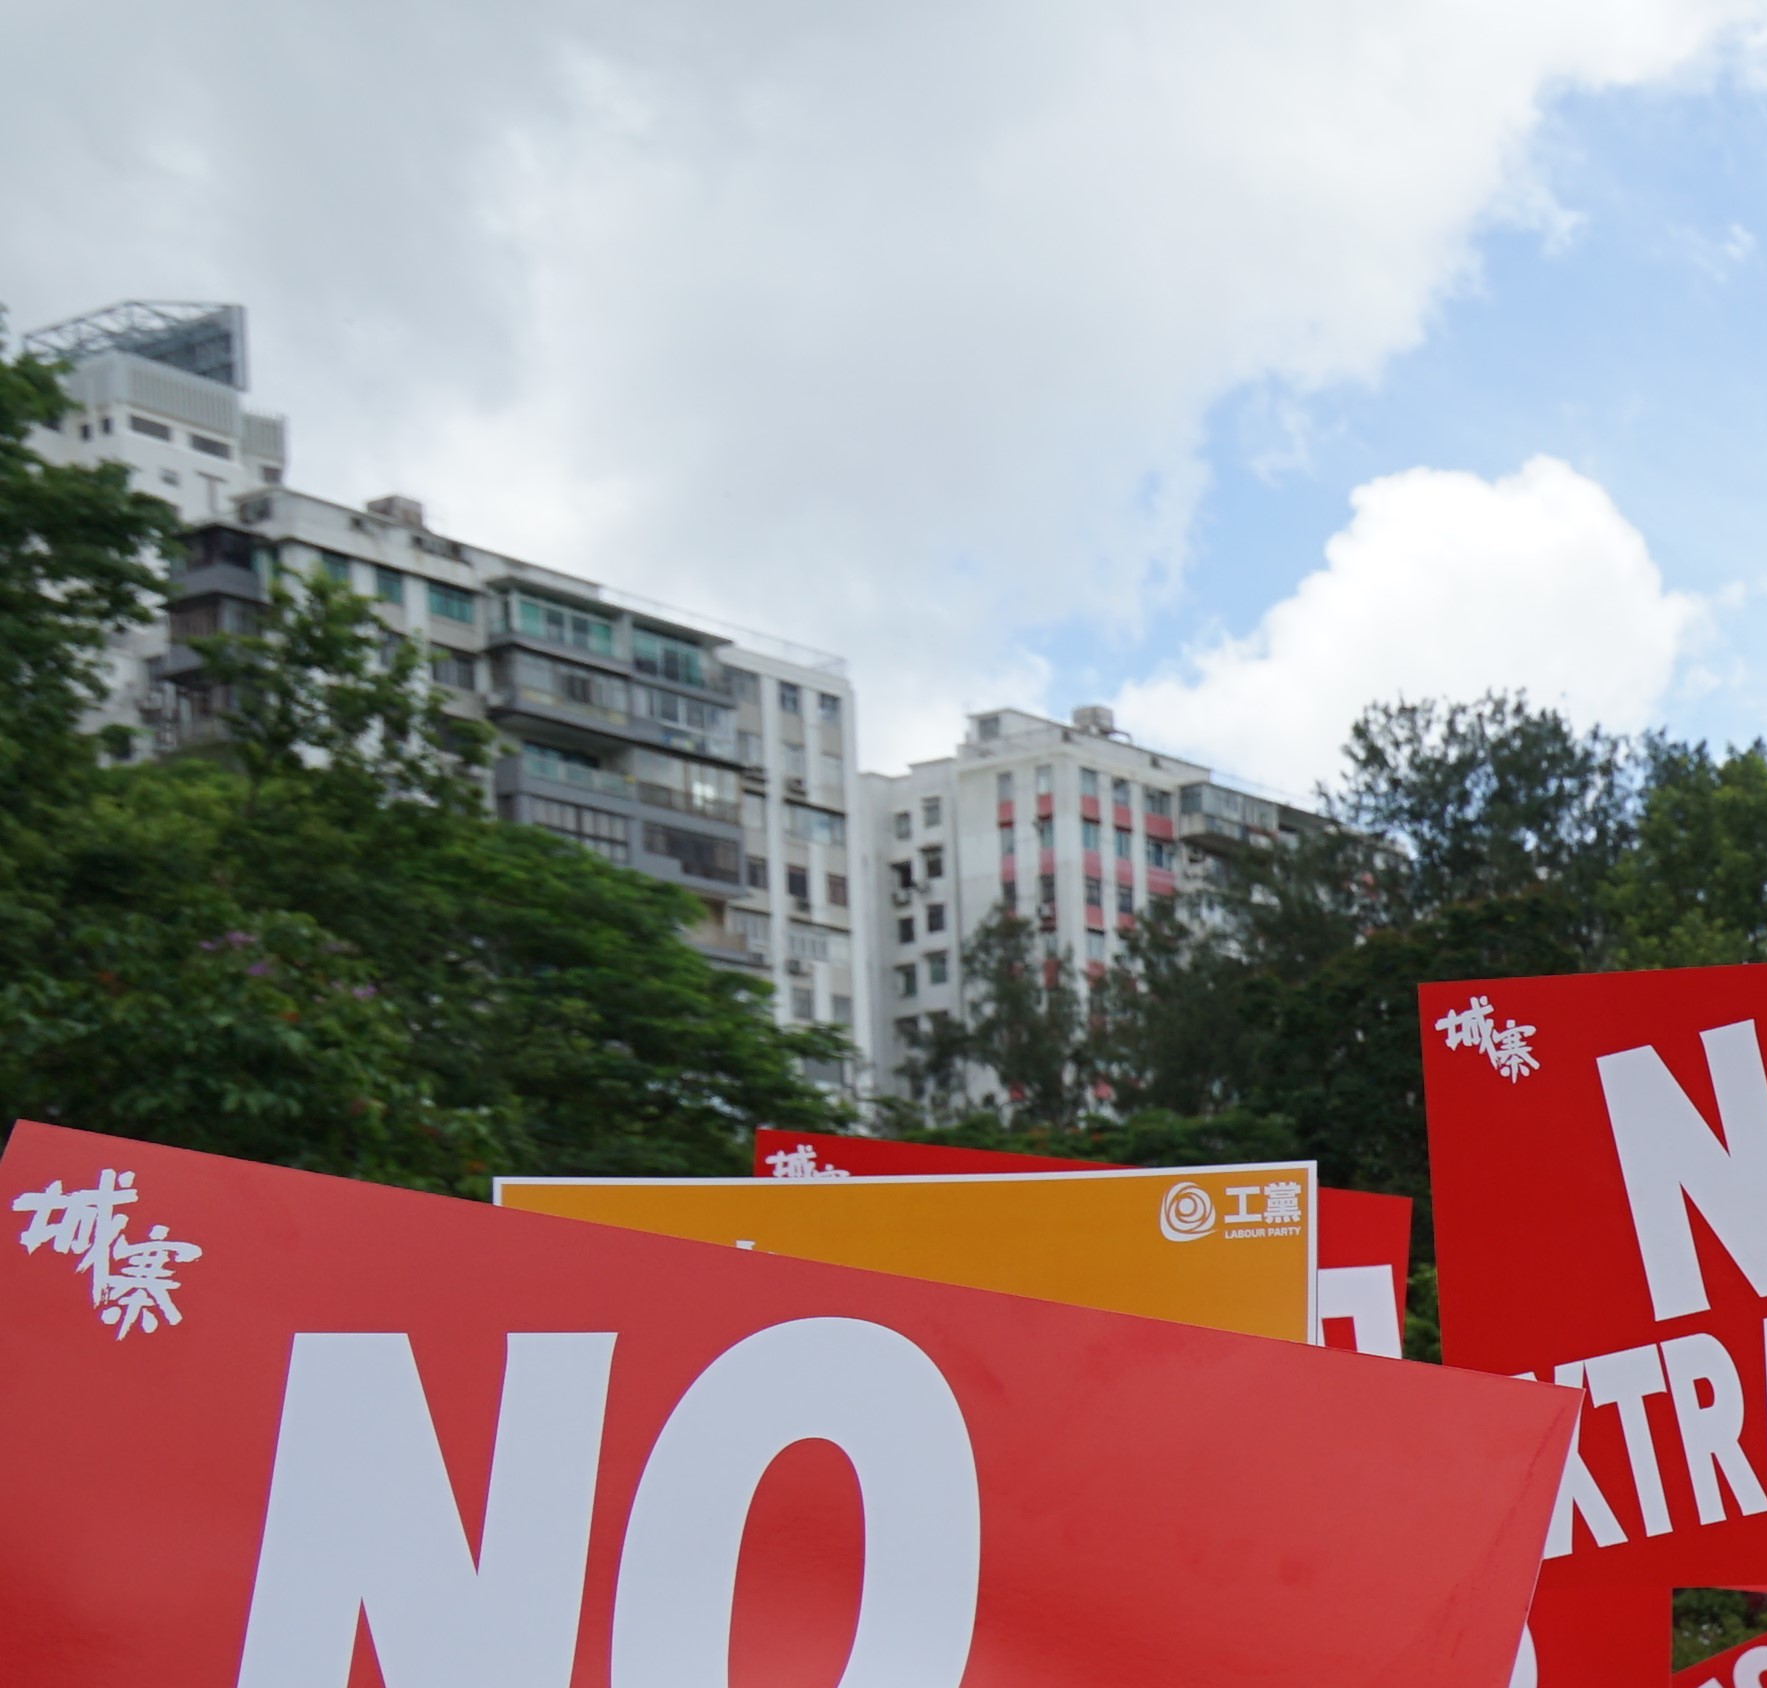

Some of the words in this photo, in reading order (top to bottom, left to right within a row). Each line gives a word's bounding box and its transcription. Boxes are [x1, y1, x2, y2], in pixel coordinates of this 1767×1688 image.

[1436, 996, 1540, 1084] 城寨
[765, 1143, 852, 1177] 城
[1224, 1181, 1301, 1224] 工黨
[1225, 1228, 1266, 1239] LABOUR
[1268, 1226, 1302, 1237] PARTY
[12, 1168, 203, 1341] 城寨
